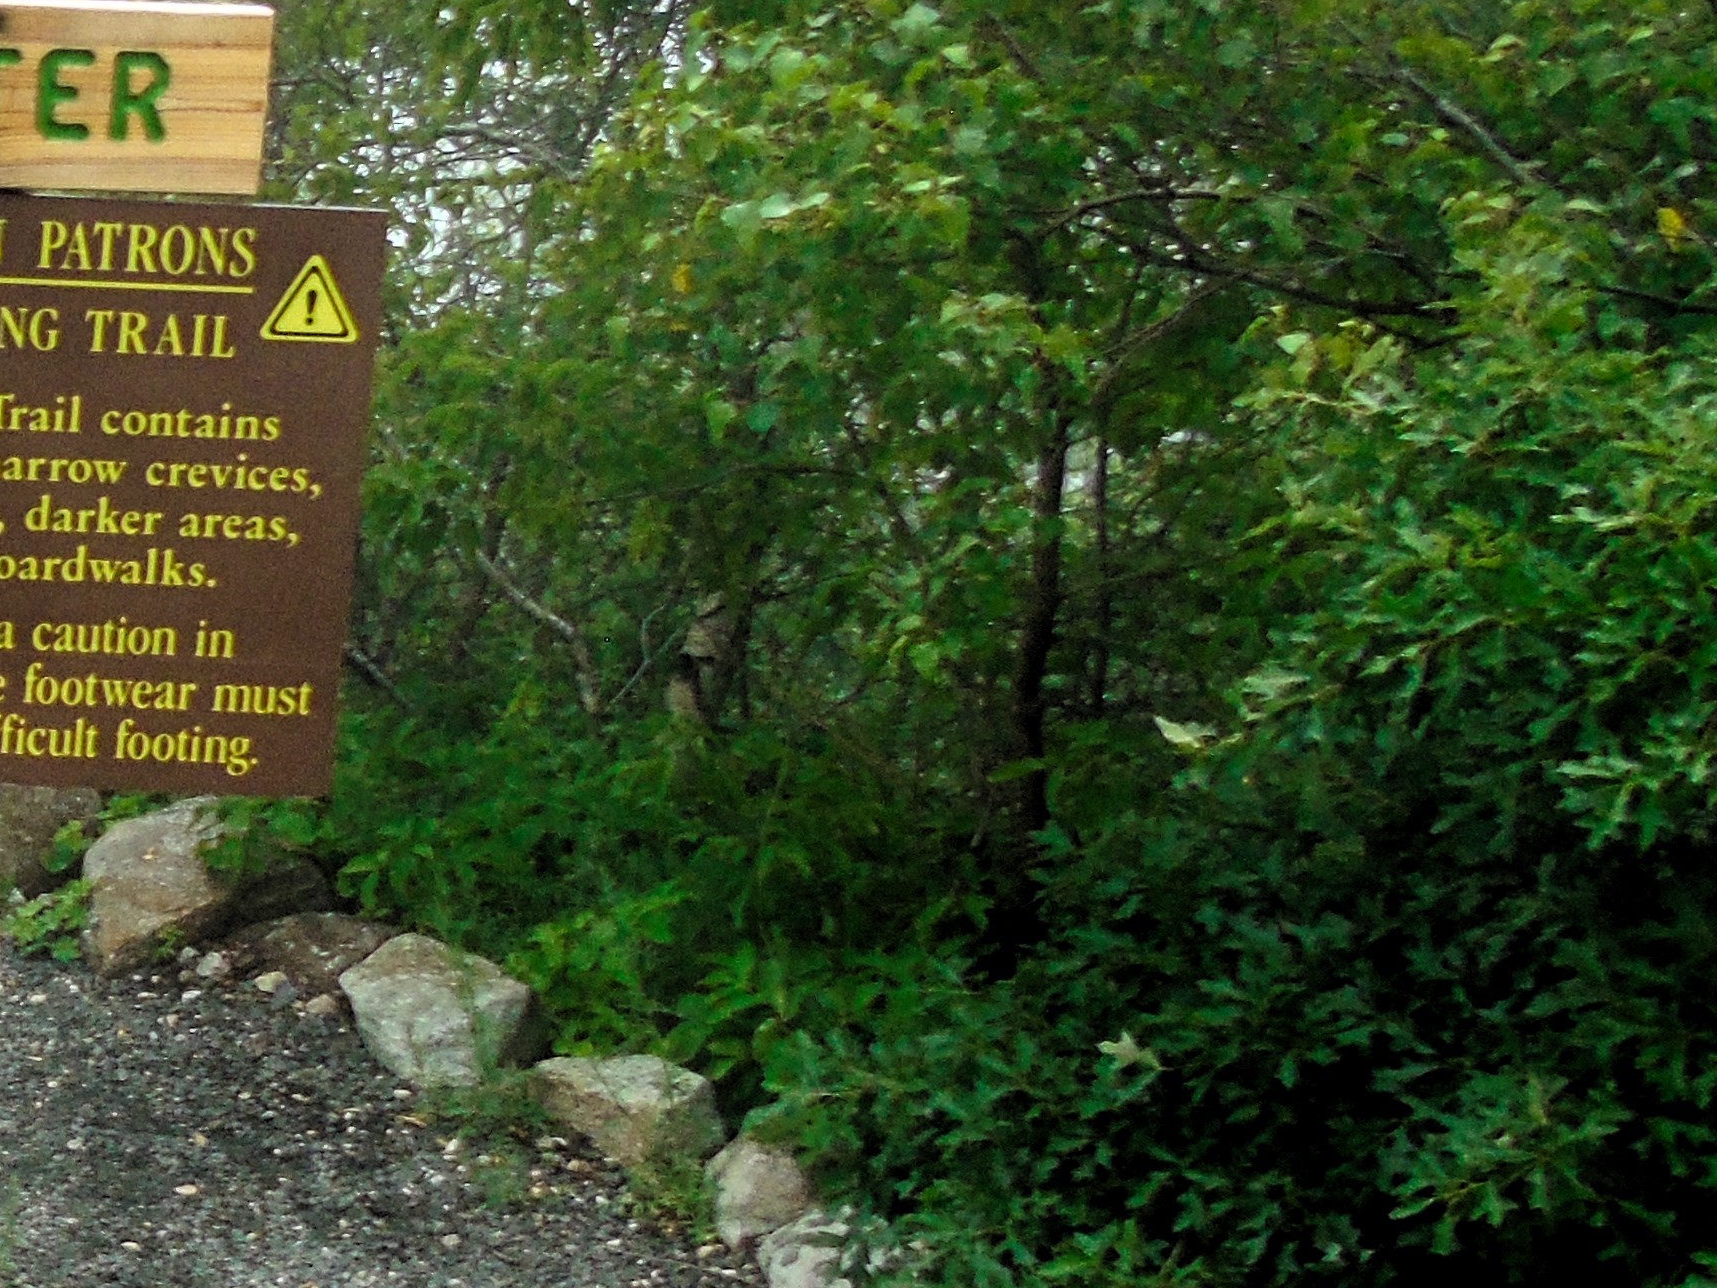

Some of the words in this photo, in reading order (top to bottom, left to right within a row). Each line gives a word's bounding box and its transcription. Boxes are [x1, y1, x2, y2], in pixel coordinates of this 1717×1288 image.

[39, 219, 258, 277] PATRONS
[87, 308, 236, 358] TRAIL
[100, 402, 281, 441] contains
[145, 453, 323, 497] crevices,
[24, 493, 162, 536] darker
[180, 513, 301, 546] areas,
[32, 616, 177, 656] caution
[196, 620, 234, 659] in
[24, 662, 198, 711] footwear
[213, 683, 312, 716] must
[116, 718, 259, 776] footing.
